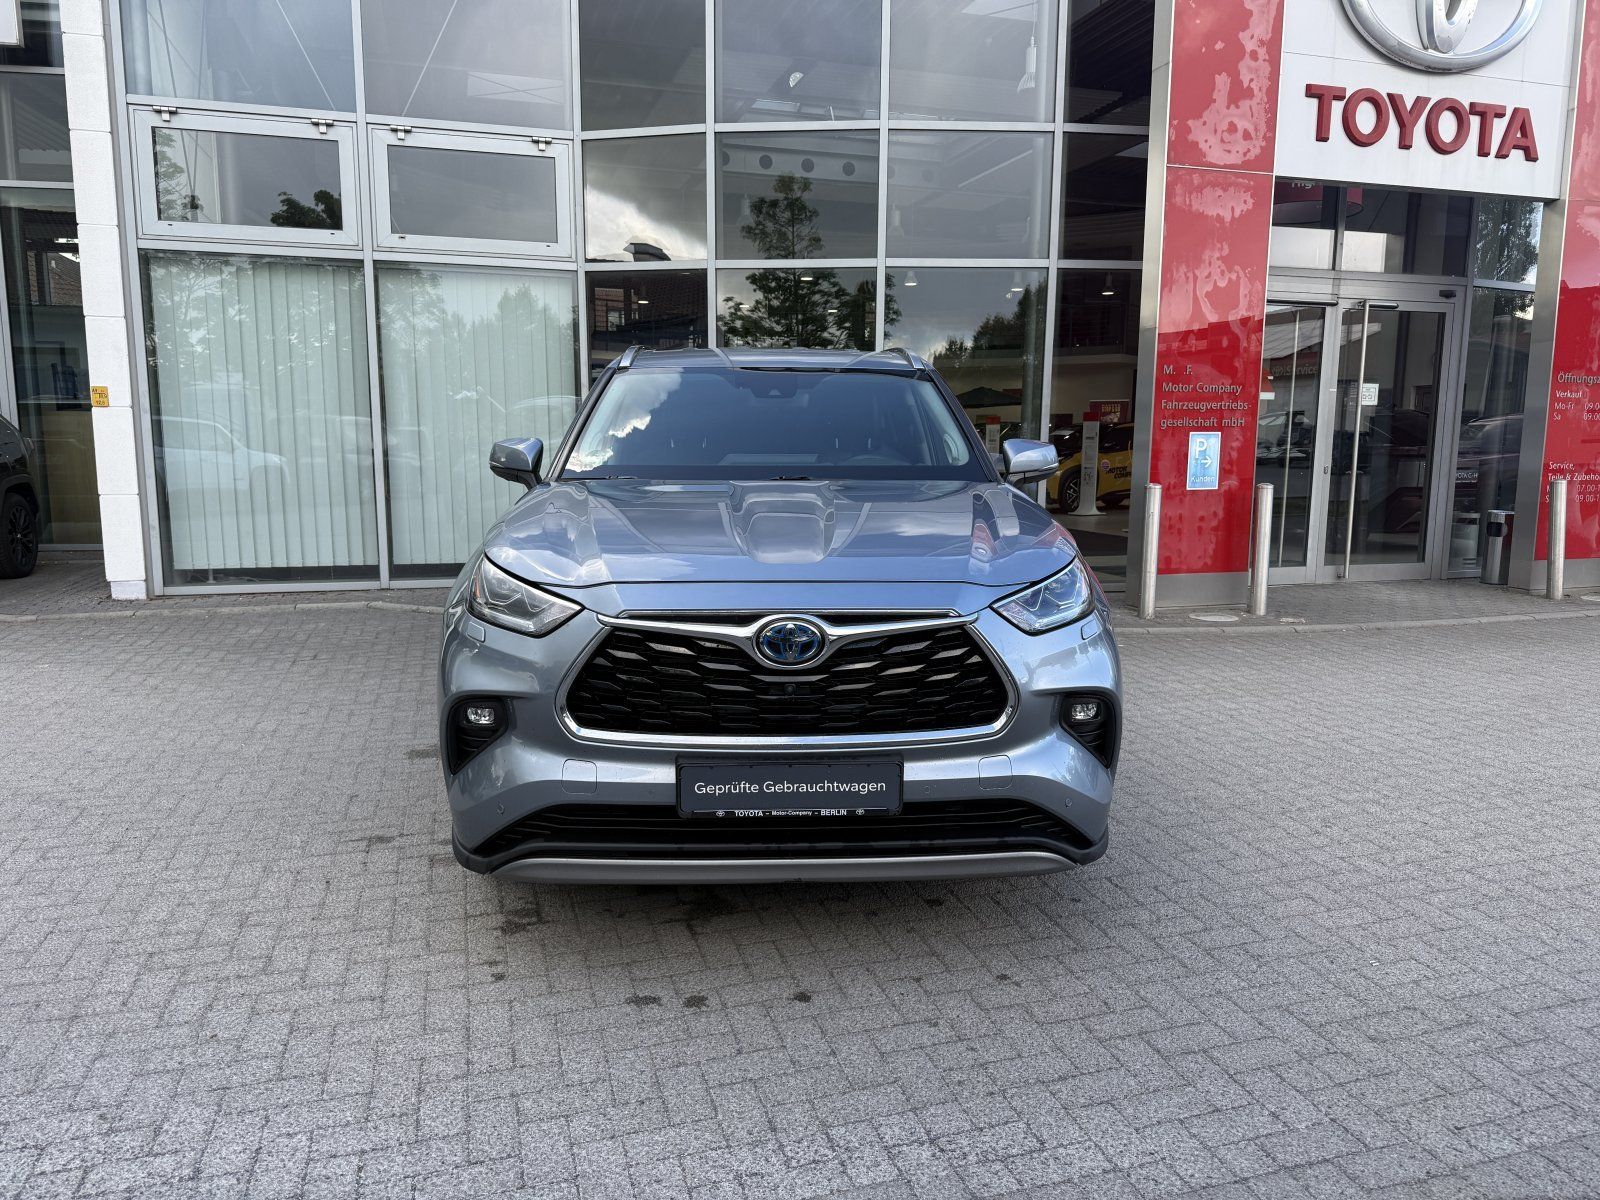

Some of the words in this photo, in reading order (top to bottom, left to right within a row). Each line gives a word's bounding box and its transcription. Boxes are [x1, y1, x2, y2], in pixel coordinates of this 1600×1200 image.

[1305, 83, 1539, 162] TOYOTA
[1286, 364, 1318, 375] Srvice
[1162, 382, 1193, 392] Motor
[1196, 382, 1242, 396] Company
[1556, 389, 1582, 398] Verkauf
[1161, 400, 1252, 412] Fahrzeugvertriebs-
[1554, 401, 1575, 411] Mo-Fr
[1553, 411, 1562, 420] Sa
[1160, 417, 1218, 430] gesellschaft
[1222, 417, 1245, 427] mbH
[1194, 438, 1208, 459] P
[1549, 461, 1575, 470] Service,
[1191, 475, 1216, 483] Kunden
[1548, 473, 1564, 481] Teile
[694, 781, 759, 796] Geprüfte
[763, 780, 886, 794] Gebrauchtwagen
